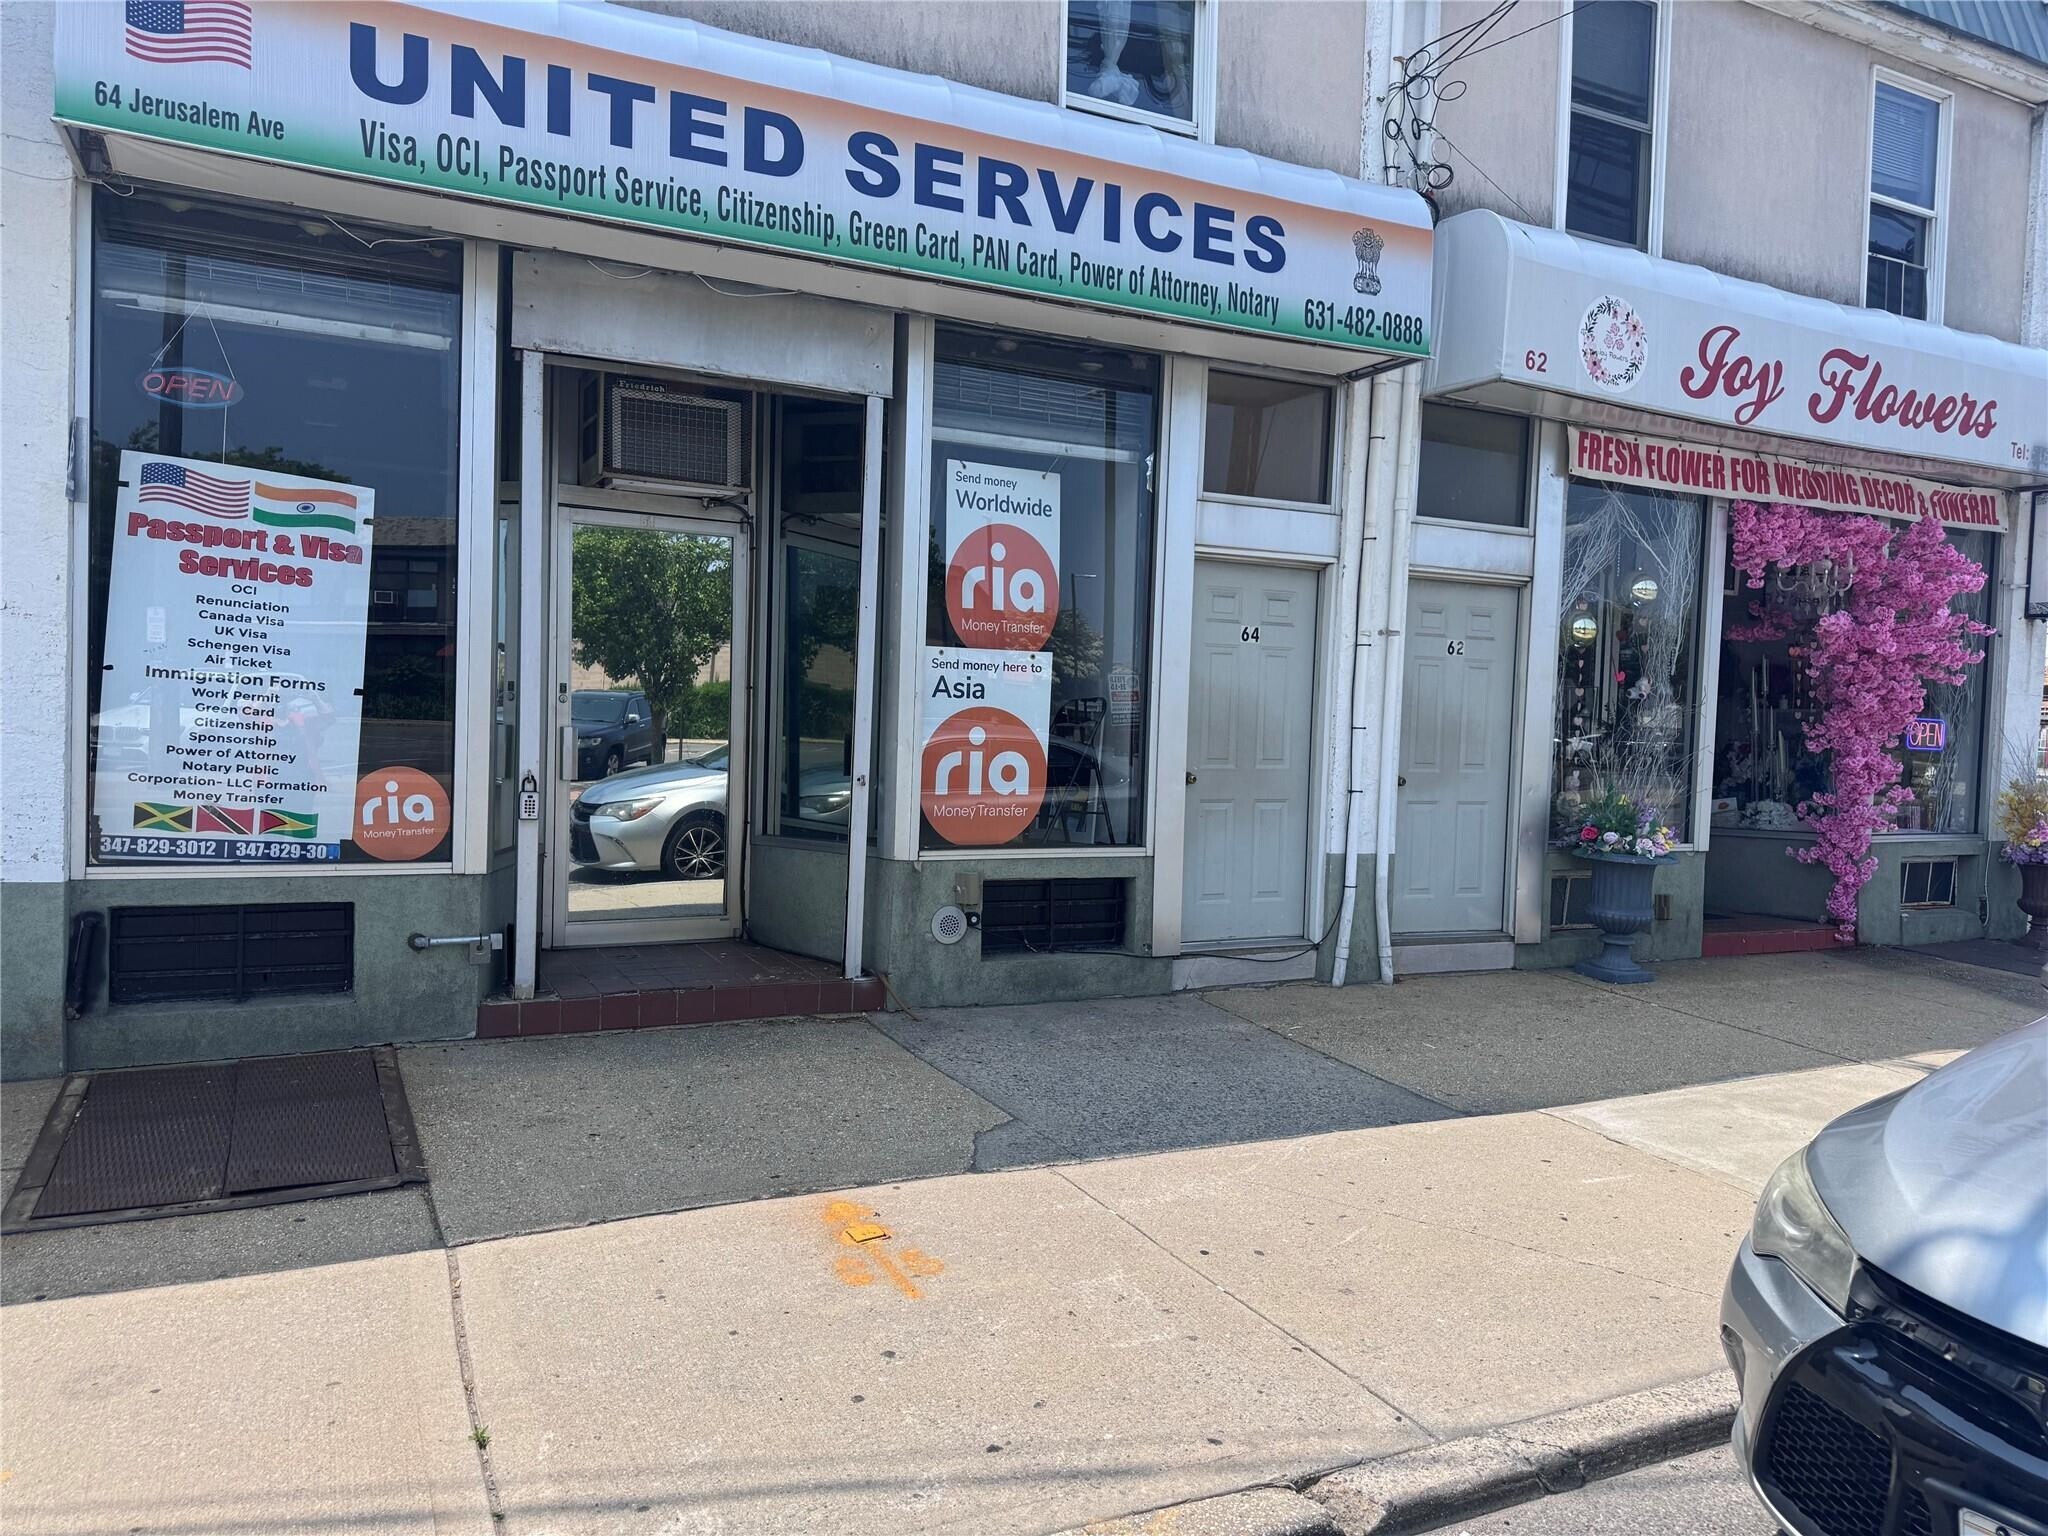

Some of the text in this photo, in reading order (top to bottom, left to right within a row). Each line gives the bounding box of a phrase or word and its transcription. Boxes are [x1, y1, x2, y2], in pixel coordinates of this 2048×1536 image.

[95, 81, 285, 140] 64 Jerusalem Ave
[350, 21, 1287, 274] UNITED SERVICES
[360, 118, 1280, 326] Visa, OCI, Passport Service, Citizenship, Green Card, PAN Card, Power of Attorney, Notary
[1304, 298, 1424, 346] 631-482-0888
[1525, 349, 1548, 373] 62
[142, 372, 237, 401] OPEN
[618, 379, 666, 393] Friedrich
[1680, 325, 1997, 439] Joy Flowers
[2010, 441, 2030, 461] Tel:
[955, 471, 1018, 490] Send money
[1577, 430, 1643, 478] FRESH
[1645, 444, 1726, 490] FLOWER
[1730, 456, 1771, 495] FOR
[1773, 462, 1862, 506] WEDDING
[1860, 476, 1917, 516] DECOR
[1918, 491, 1929, 517] &
[1929, 488, 2001, 526] FUNERAL
[956, 489, 1053, 518] Worldwide
[127, 511, 363, 564] Passport & Visa
[179, 549, 313, 587] Services
[961, 542, 1045, 614] ria
[231, 584, 257, 596] OCI
[196, 595, 290, 614] Renunciation
[198, 609, 285, 627] Canada Visa
[214, 625, 268, 640] UK Visa
[1241, 626, 1260, 643] 64
[187, 638, 292, 657] Schengen Visa
[1447, 640, 1465, 656] 62
[204, 654, 273, 669] Air Ticket
[931, 657, 1043, 673] Send money here to
[145, 665, 327, 692] Immigration Forms
[931, 674, 986, 700] Asia
[191, 687, 281, 703] Work Permit
[195, 702, 275, 718] Green Card
[194, 717, 274, 733] Citizenship
[1908, 720, 1945, 747] OPEN
[189, 731, 277, 747] Sponsorship
[166, 745, 297, 764] Power of Attorney
[935, 725, 1030, 796] ria
[182, 760, 279, 776] Notary Public
[128, 772, 328, 793] Corporation- LLC Formation
[173, 789, 284, 805] Money Transfer
[362, 780, 435, 826] ria
[100, 837, 216, 857] 347-829-3012
[236, 842, 340, 860] 347-829-30
